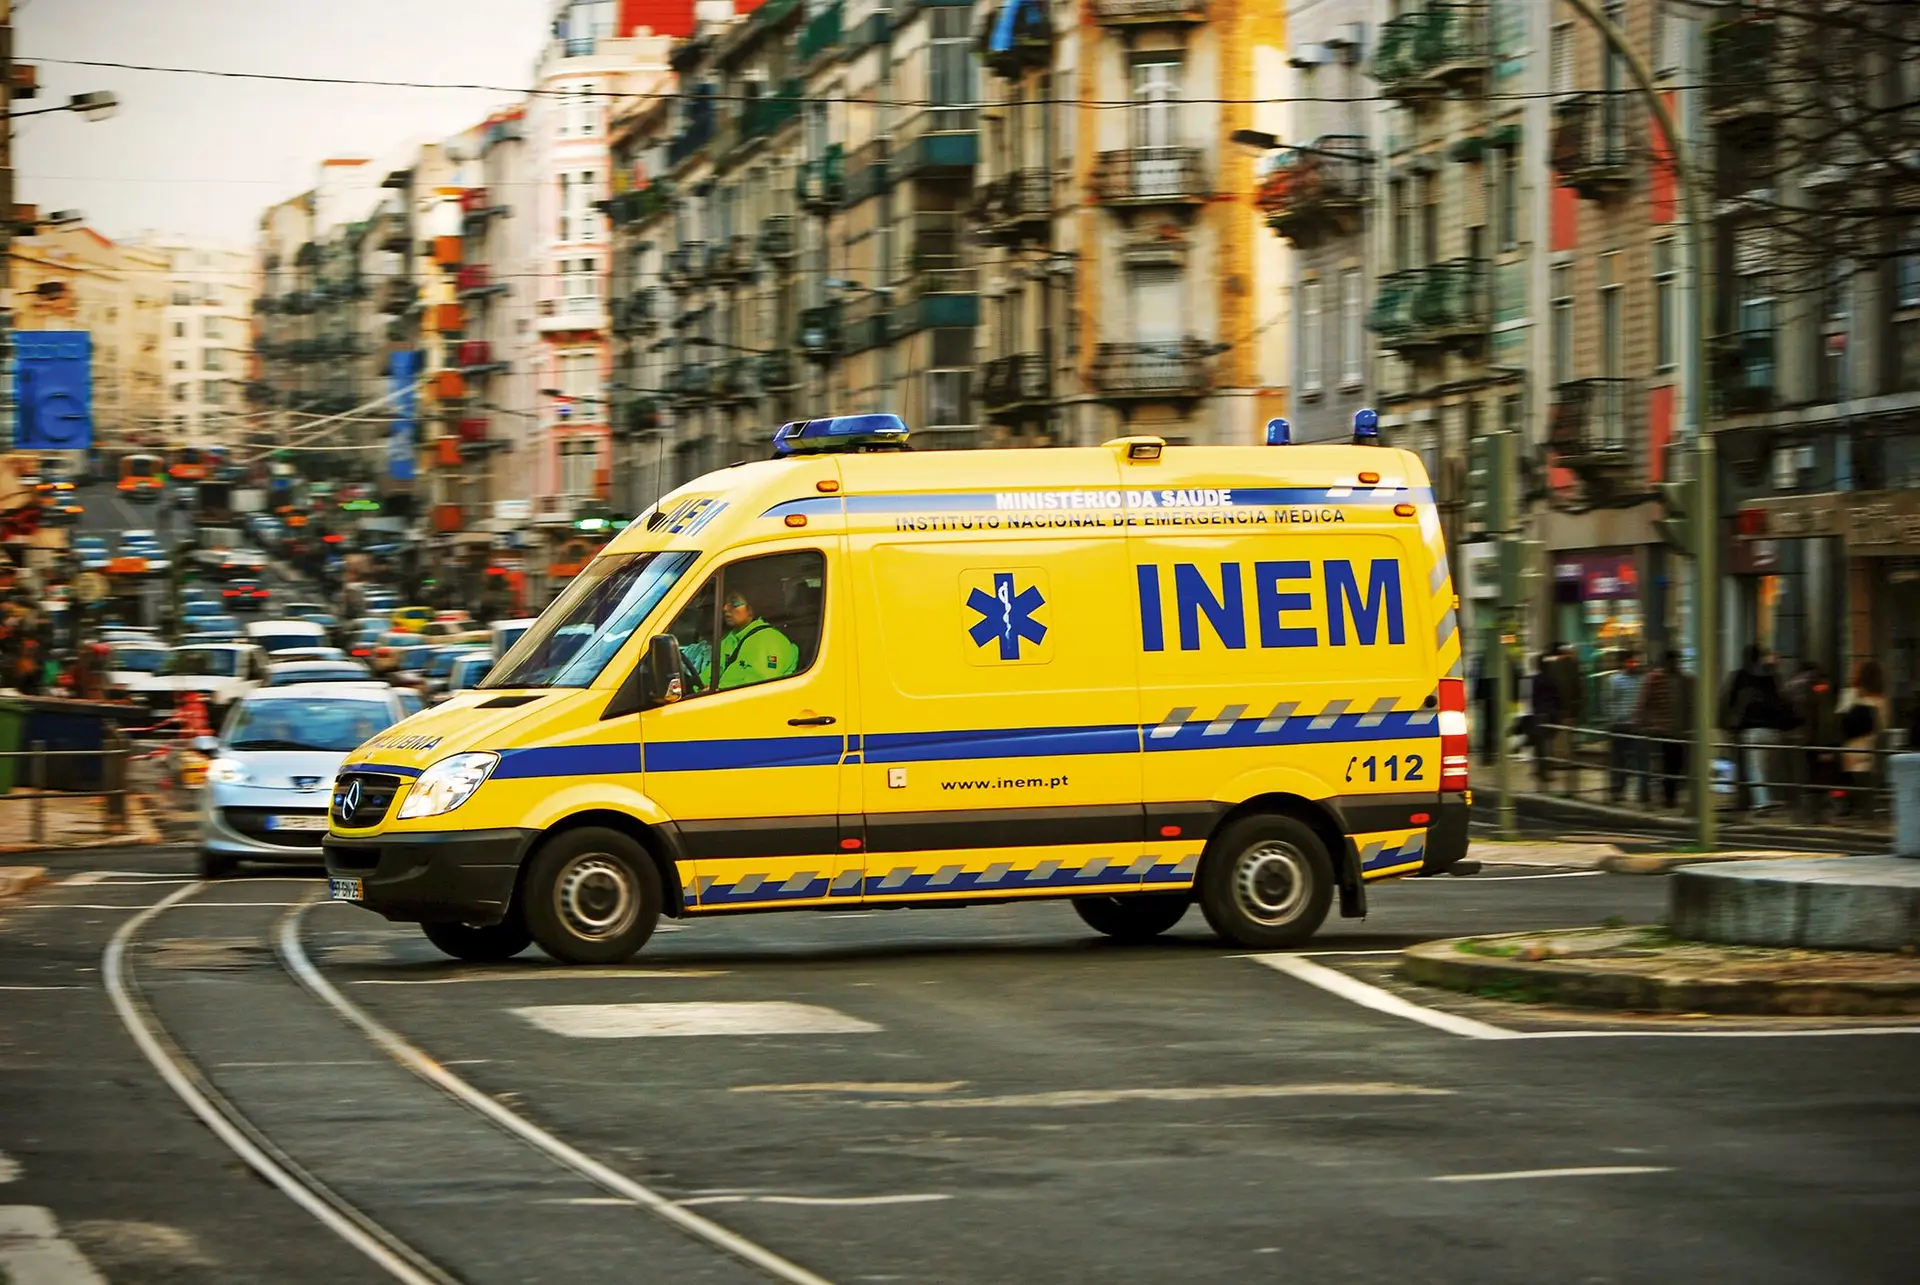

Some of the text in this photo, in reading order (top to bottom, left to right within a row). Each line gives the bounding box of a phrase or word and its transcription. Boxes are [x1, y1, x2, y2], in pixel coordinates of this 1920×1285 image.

[1126, 491, 1157, 508] DA
[895, 515, 1000, 531] INSTITUTO
[1007, 513, 1106, 529] NACIONAL
[1112, 512, 1137, 527] DE
[1136, 559, 1406, 652] INEM
[1362, 754, 1424, 782] 112
[941, 775, 1069, 790] www.inem.pt
